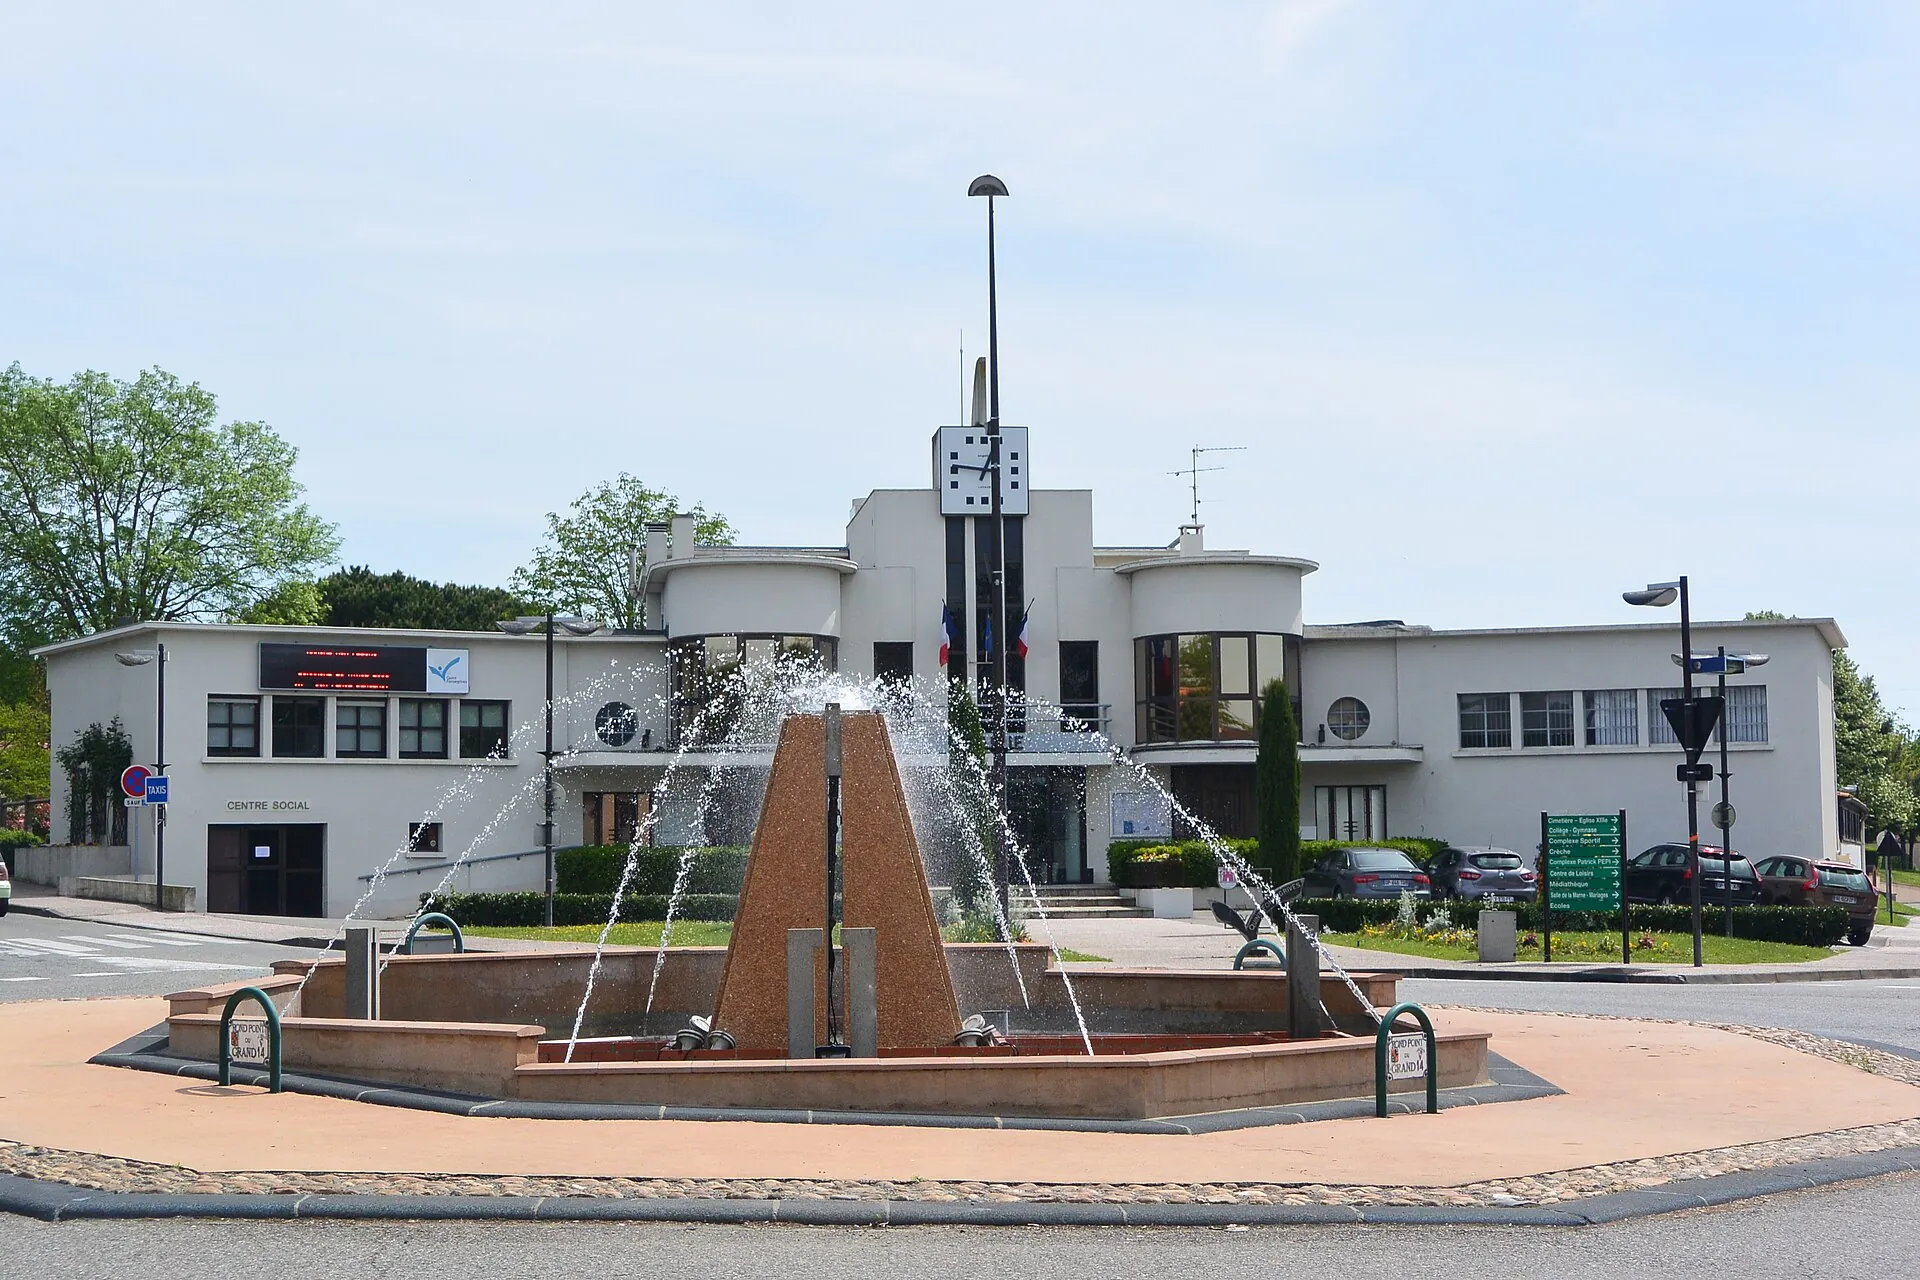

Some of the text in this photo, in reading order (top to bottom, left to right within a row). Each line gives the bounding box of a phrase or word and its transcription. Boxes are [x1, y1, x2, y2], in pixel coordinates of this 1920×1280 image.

[147, 785, 167, 795] TAXIS
[227, 800, 310, 810] CENTRE SOCIAL
[1548, 827, 1568, 835] Collège
[1579, 837, 1601, 845] Sportif
[1549, 858, 1577, 866] Complexe
[1575, 869, 1594, 877] Loisirs
[1549, 880, 1589, 888] Médiathèque
[1550, 891, 1561, 899] Salle
[248, 1024, 264, 1033] POINT
[1408, 1039, 1423, 1047] POINT
[231, 1046, 265, 1058] GRAND 14
[1392, 1060, 1424, 1073] GRAND 14
